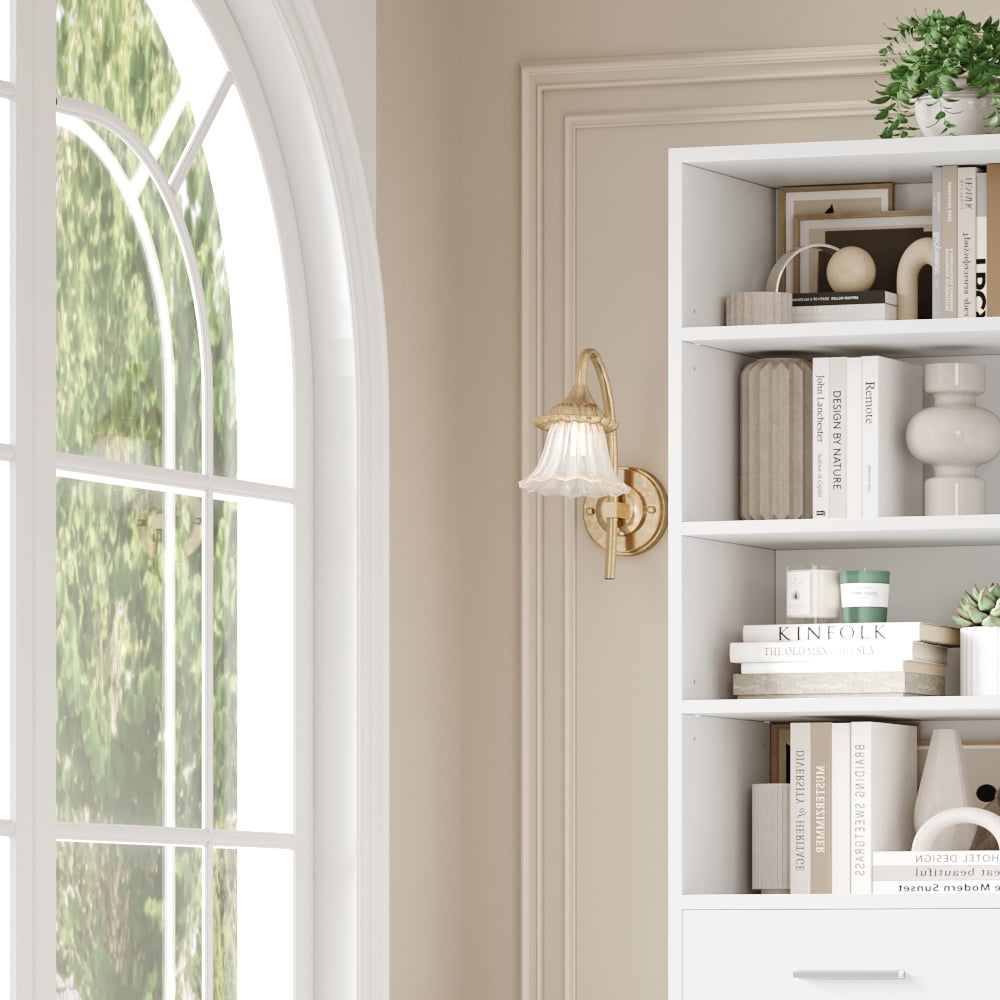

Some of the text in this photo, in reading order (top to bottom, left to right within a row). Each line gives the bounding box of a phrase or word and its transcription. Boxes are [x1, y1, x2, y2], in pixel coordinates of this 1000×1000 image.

[815, 375, 825, 444] John Lanchester
[864, 381, 876, 424] Remote
[832, 390, 842, 490] DESIGN BY NATURE
[763, 647, 783, 656] THE
[785, 647, 805, 656] OLD
[779, 624, 887, 641] KINFOLK
